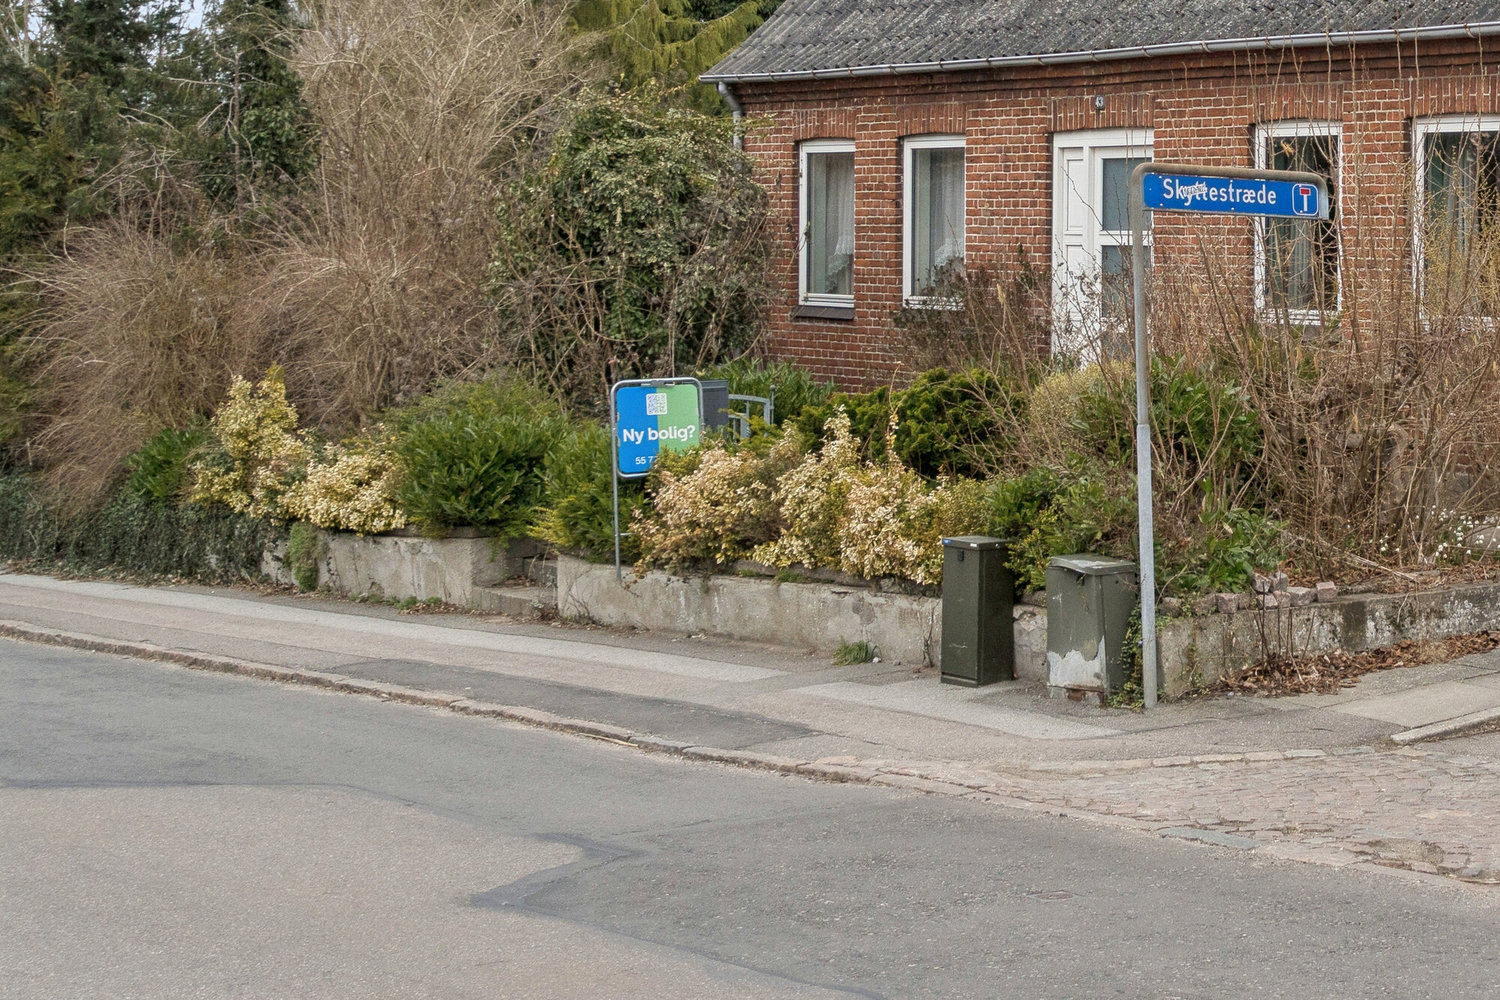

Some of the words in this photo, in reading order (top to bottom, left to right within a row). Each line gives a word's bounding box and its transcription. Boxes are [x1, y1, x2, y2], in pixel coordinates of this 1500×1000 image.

[1163, 178, 1277, 206] Skyttestræde
[622, 428, 645, 445] Ny
[647, 424, 696, 442] bolig?
[635, 456, 647, 465] 55
